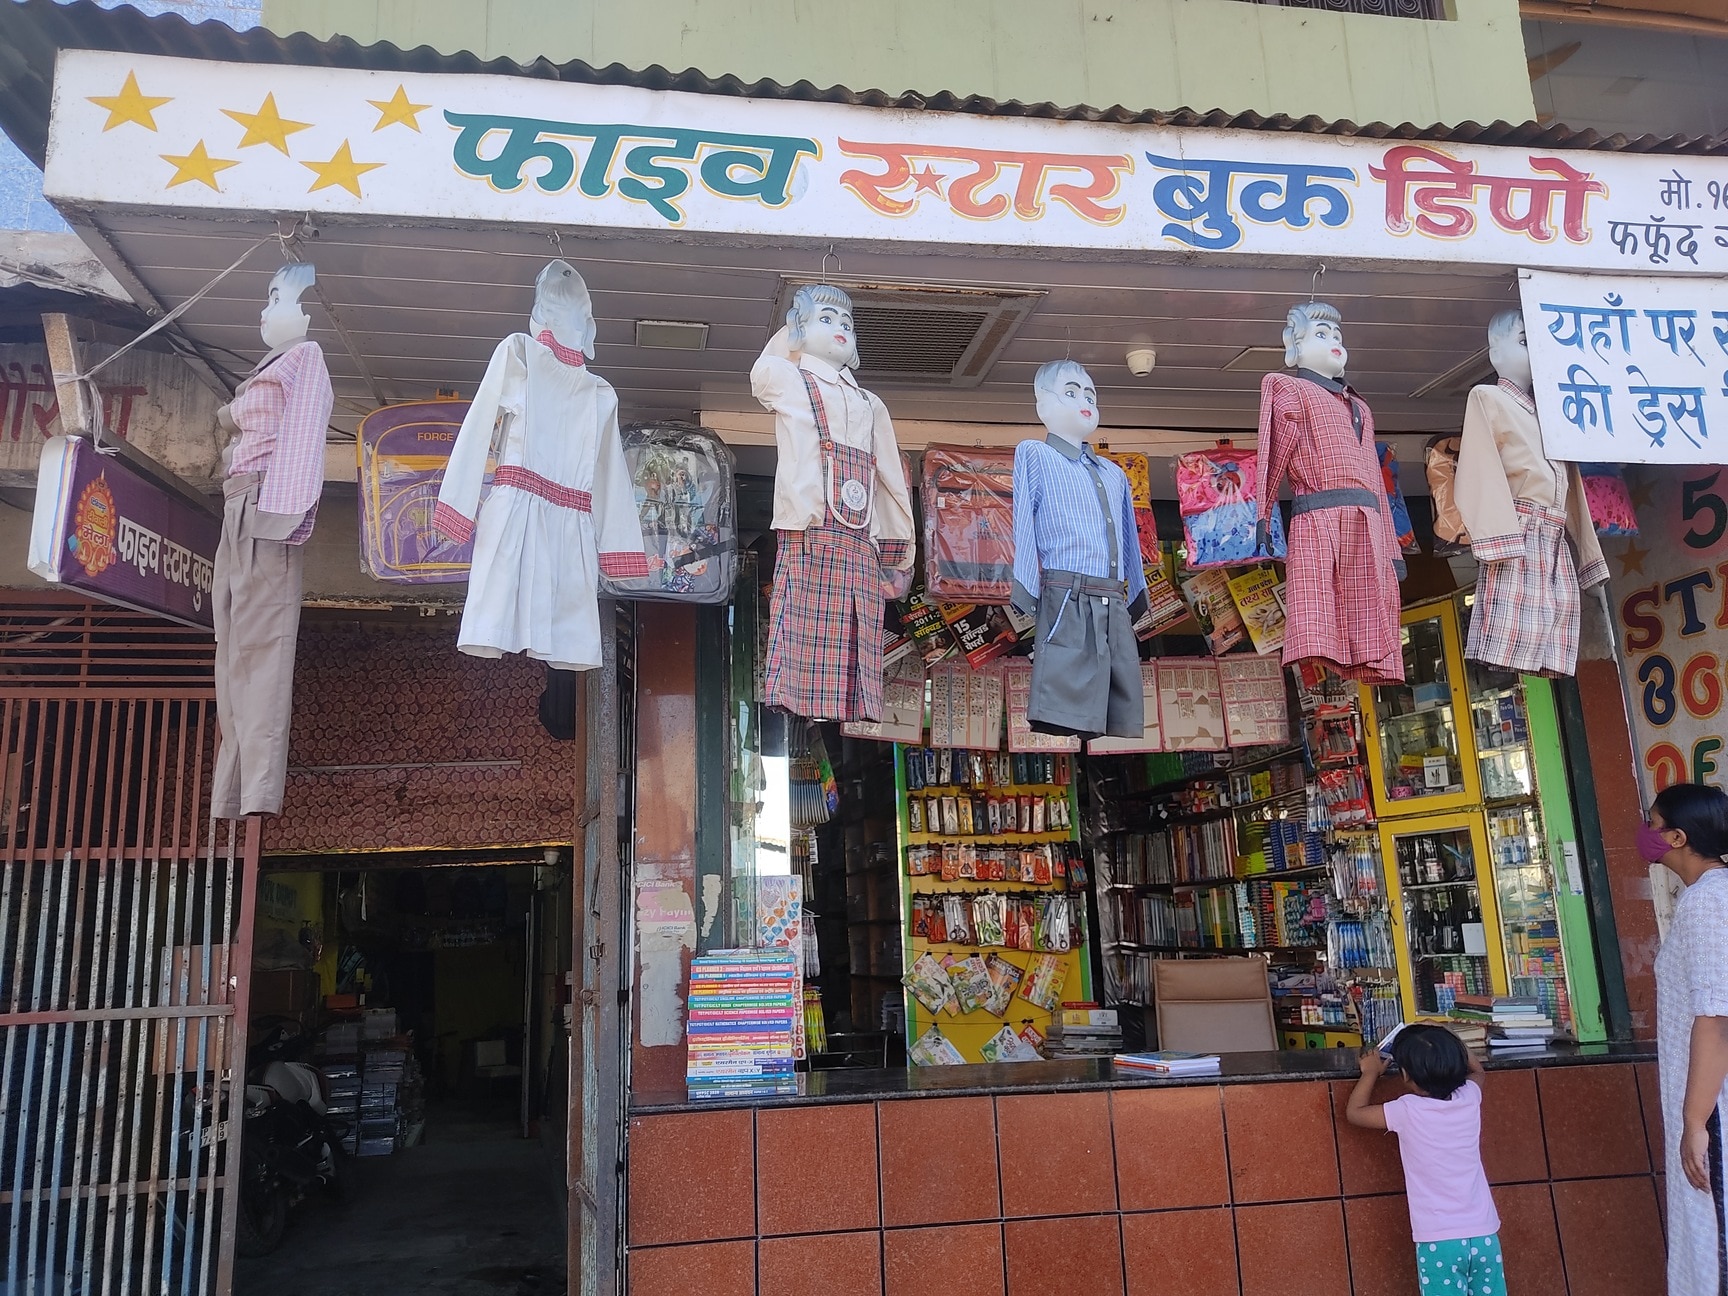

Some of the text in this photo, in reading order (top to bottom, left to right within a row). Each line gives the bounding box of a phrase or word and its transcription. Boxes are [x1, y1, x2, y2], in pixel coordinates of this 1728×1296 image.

[443, 108, 822, 227] फाइव
[1145, 151, 1358, 251] बुक
[1368, 145, 1608, 243] डिपो
[1540, 292, 1637, 366] यहाँ
[1643, 310, 1706, 367] पर
[417, 432, 454, 441] FORCE
[1558, 364, 1709, 449] की ड्रेस
[82, 524, 109, 546] मेला
[1682, 470, 1728, 549] 5
[118, 515, 213, 612] फाइव स्टार बुक
[953, 619, 970, 634] 15
[1638, 652, 1728, 729] BO
